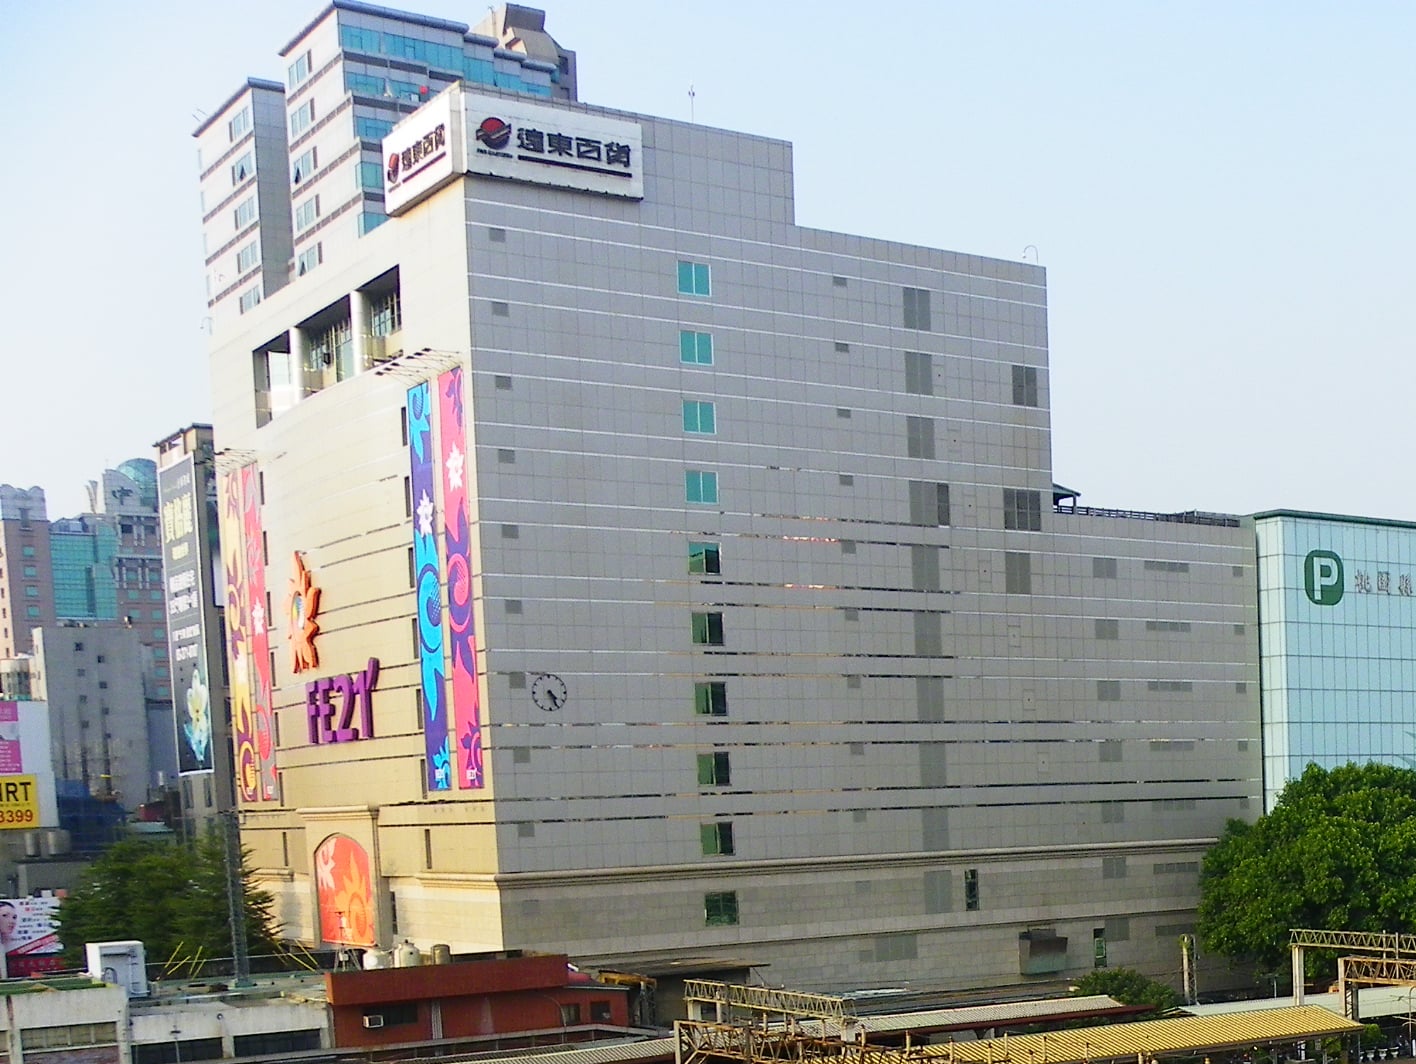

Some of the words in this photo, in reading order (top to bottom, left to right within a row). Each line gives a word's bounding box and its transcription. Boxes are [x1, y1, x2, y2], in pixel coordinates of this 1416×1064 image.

[401, 123, 446, 172] 遠東百貨
[517, 127, 631, 168] 遠東百貨
[1313, 556, 1339, 601] P
